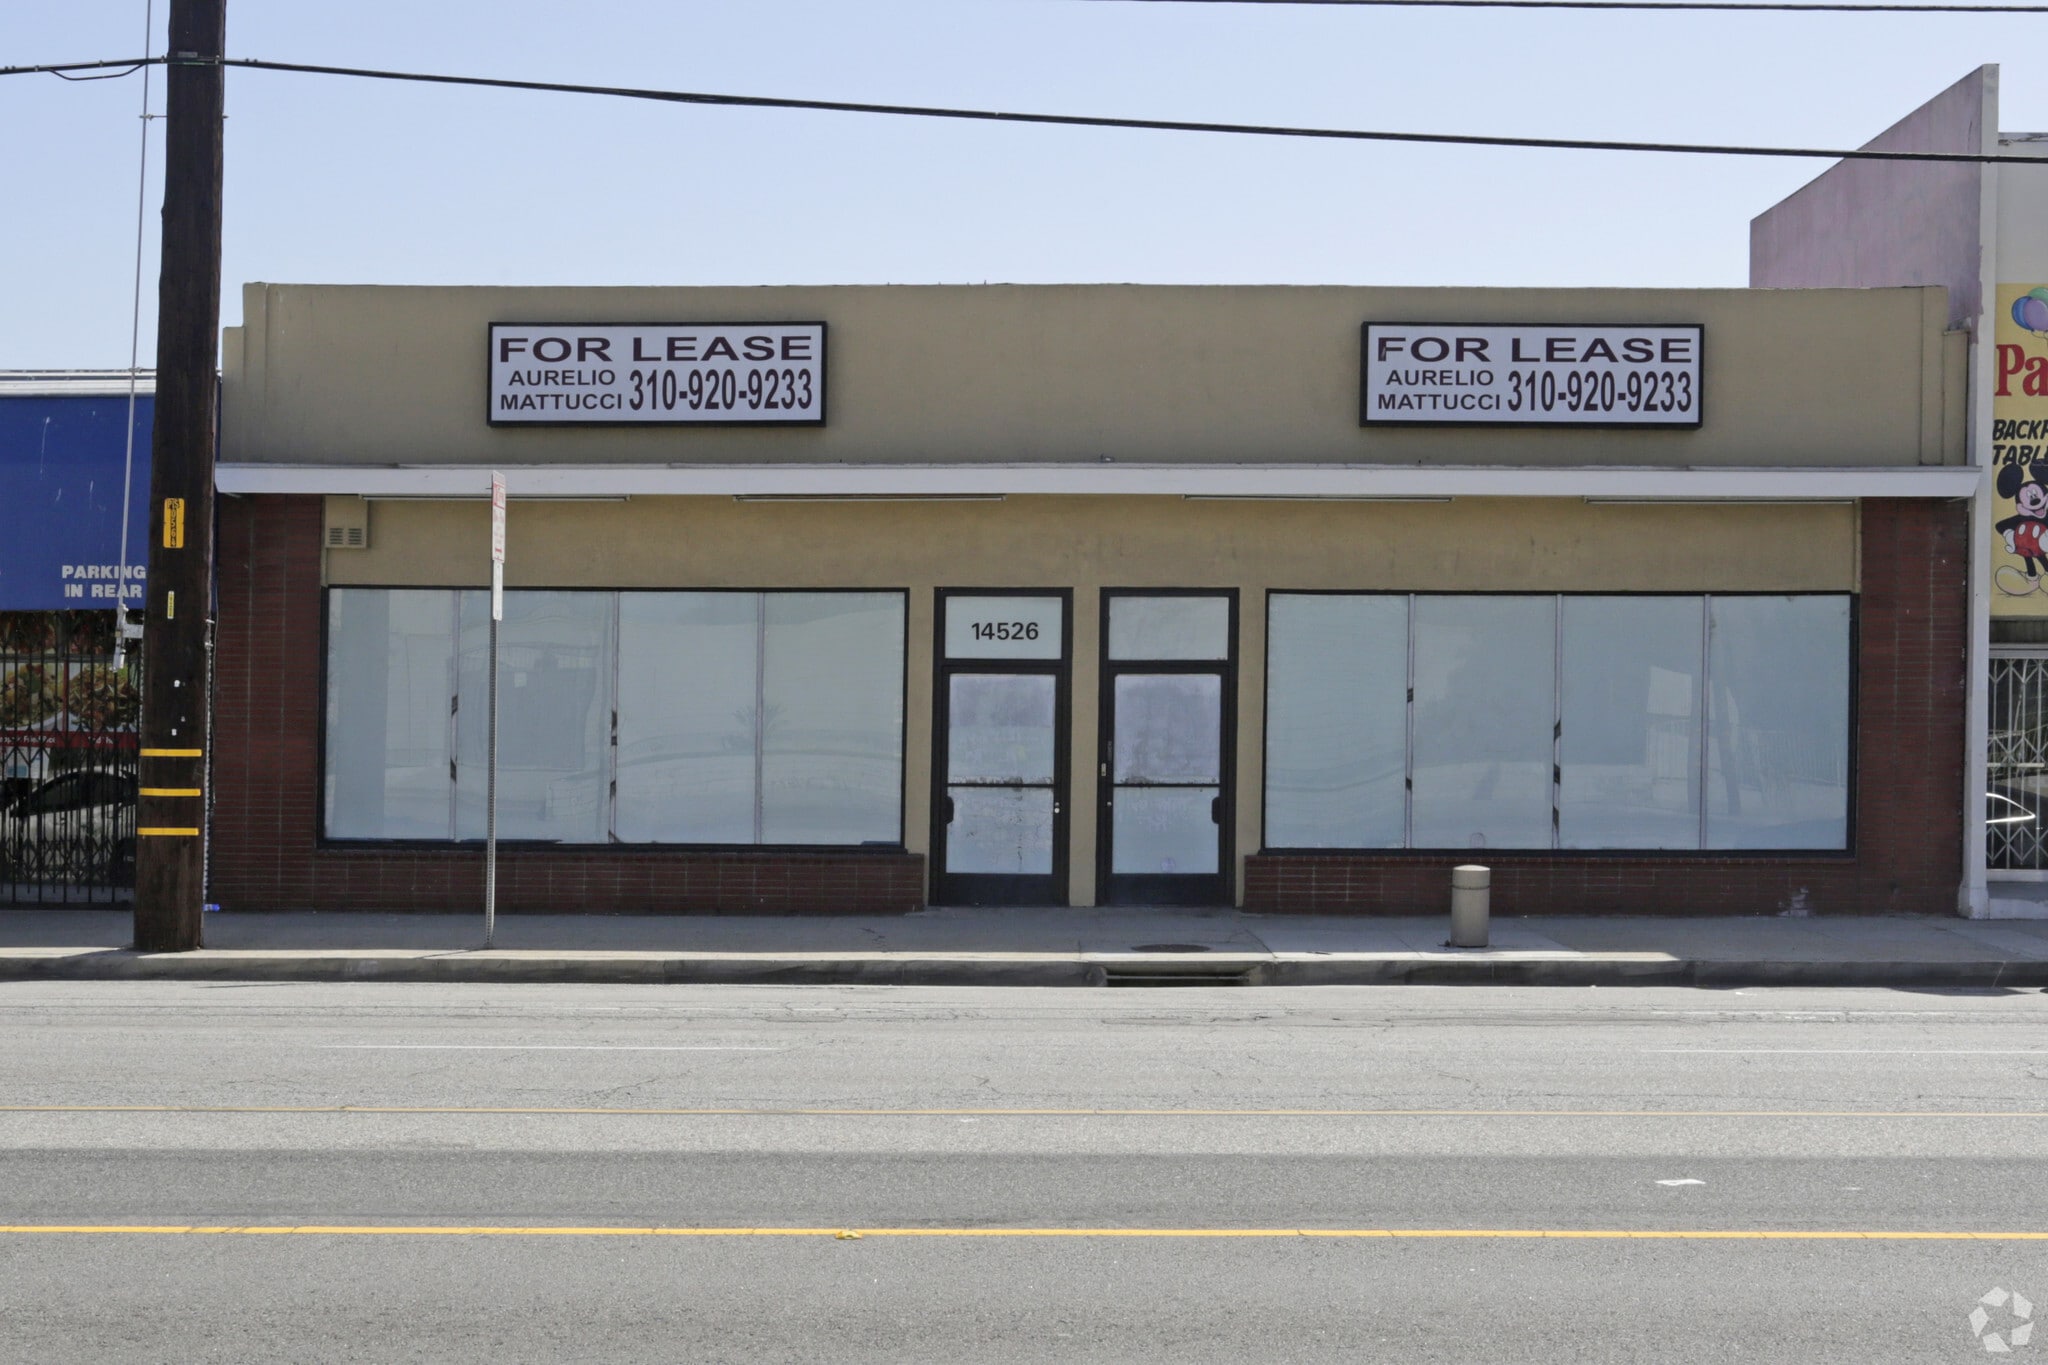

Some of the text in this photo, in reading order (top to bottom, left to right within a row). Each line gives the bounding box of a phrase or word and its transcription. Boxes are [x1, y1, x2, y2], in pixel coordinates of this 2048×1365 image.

[500, 336, 812, 363] FOR LEASE
[1377, 337, 1692, 363] FOR LEASE
[508, 369, 616, 386] AURELIO
[1386, 369, 1494, 386] AURELIO
[628, 368, 812, 410] 310-920-9233
[1507, 370, 1692, 412] 310-920-9233
[500, 393, 622, 410] MATTUCCI
[1378, 394, 1500, 411] MATTUCCI
[61, 565, 147, 579] PARKING
[64, 584, 143, 598] IN REAR
[971, 622, 1039, 640] 14526
